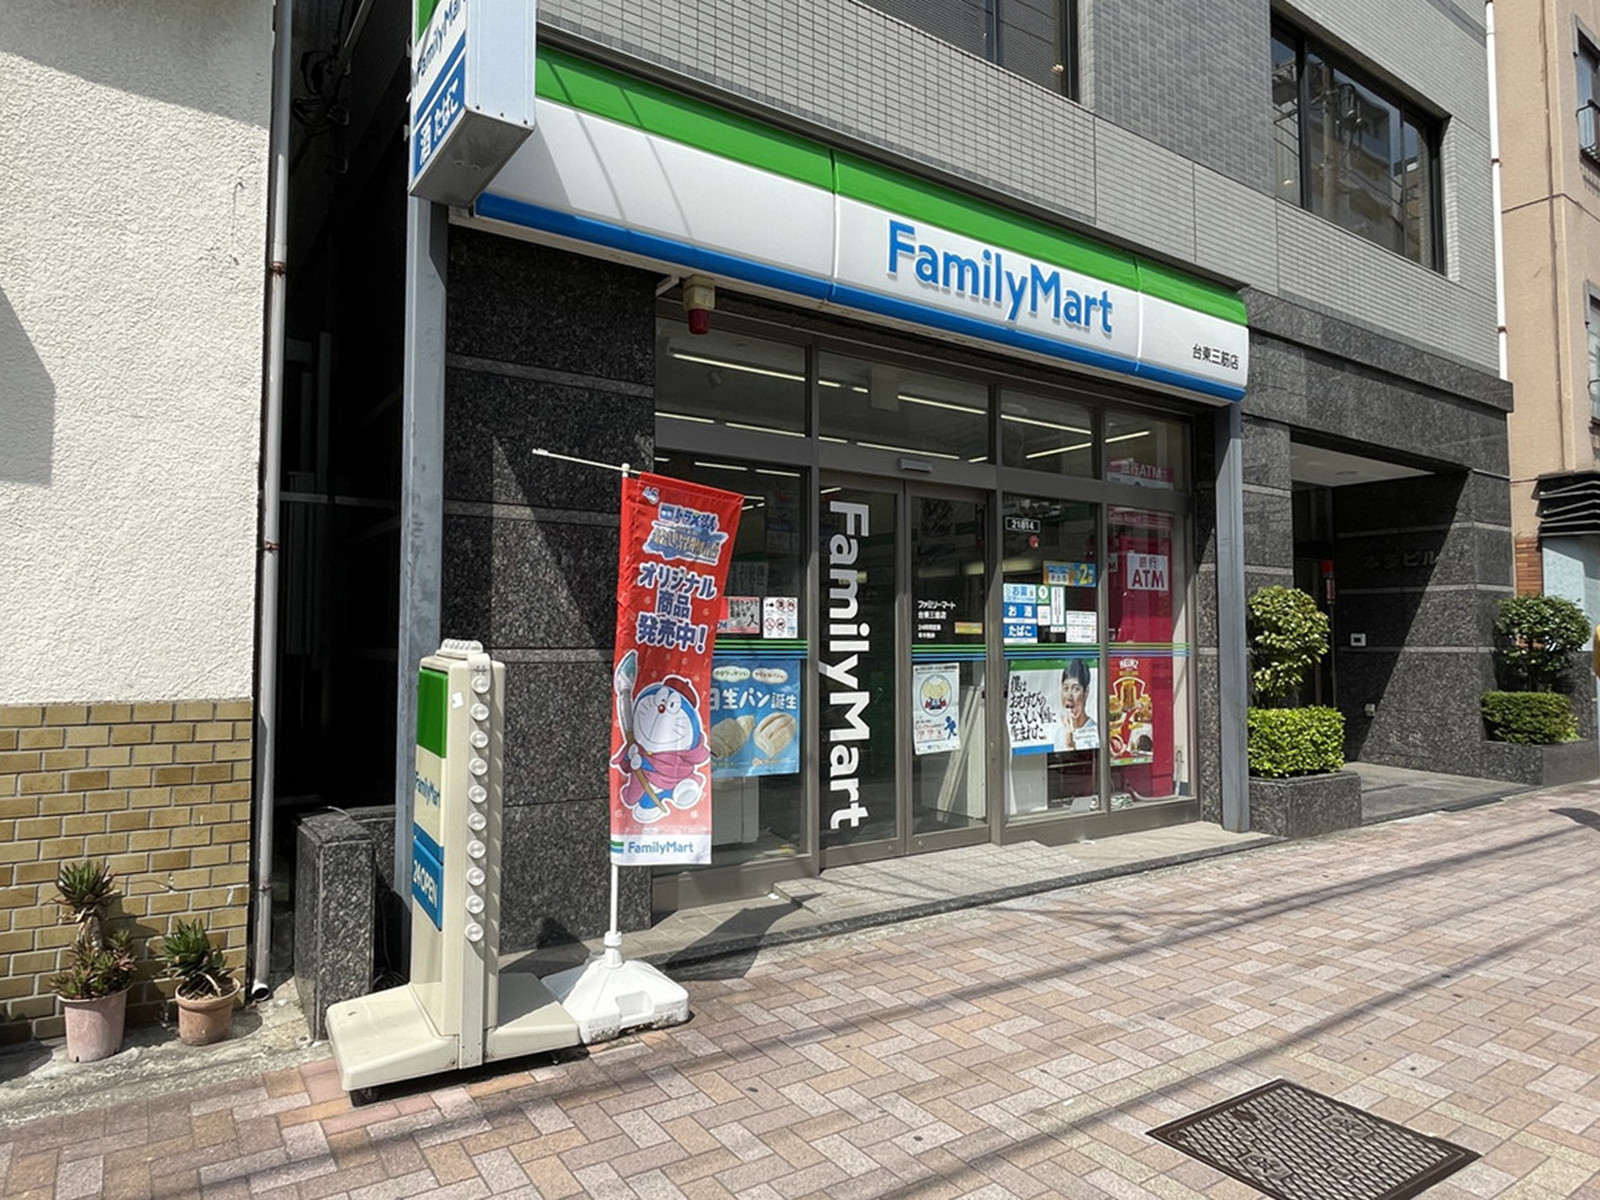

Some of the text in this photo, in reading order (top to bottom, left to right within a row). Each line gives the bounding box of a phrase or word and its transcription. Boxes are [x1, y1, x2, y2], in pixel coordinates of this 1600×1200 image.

[887, 218, 1114, 335] FamilyMart
[638, 563, 717, 599] オリジナル
[1131, 569, 1165, 588] ATM
[656, 590, 691, 619] 商品
[636, 613, 708, 653] 発売中!
[1008, 625, 1033, 637] たばこ
[819, 501, 870, 830] FamilyMart
[628, 841, 694, 854] FamilyMart
